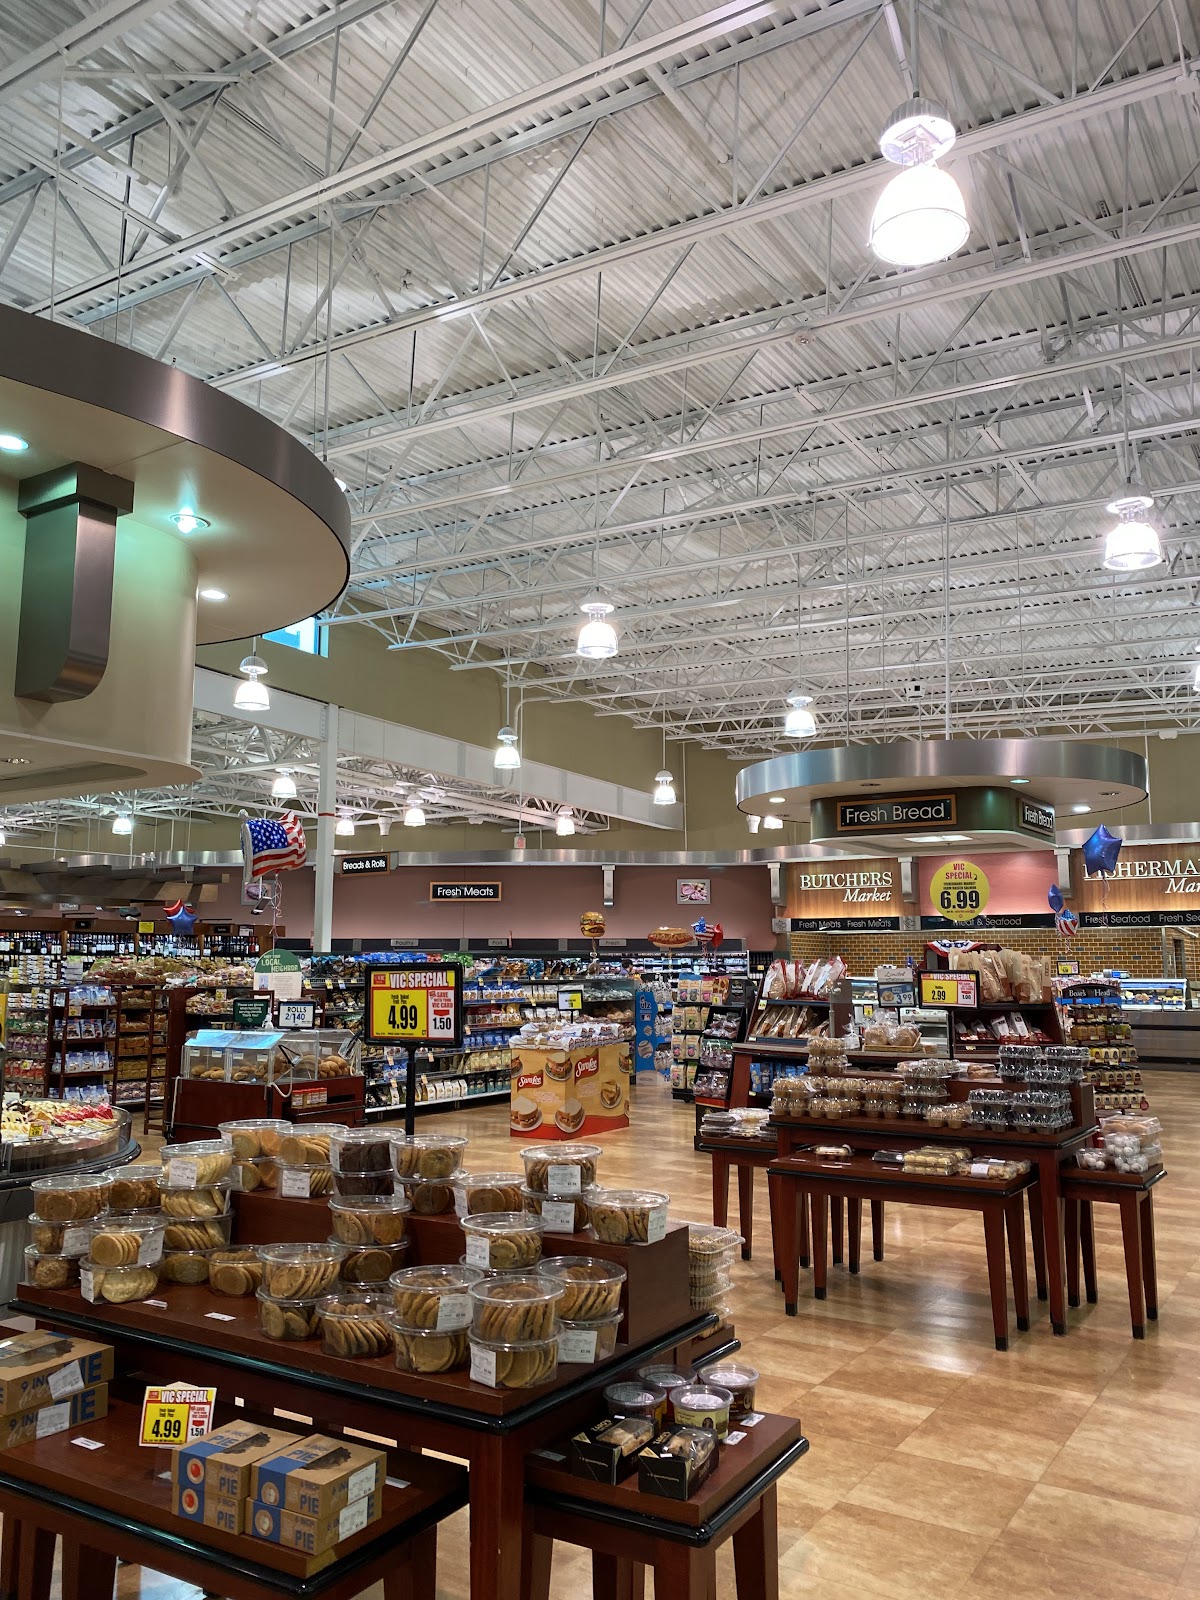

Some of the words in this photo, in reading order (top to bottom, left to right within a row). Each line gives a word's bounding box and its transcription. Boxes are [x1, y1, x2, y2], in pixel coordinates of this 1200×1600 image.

[846, 807, 888, 824] Fresh
[893, 803, 945, 821] Bread
[1025, 805, 1038, 823] Fresh
[1038, 810, 1053, 829] Bread
[343, 860, 364, 870] Breads
[365, 860, 371, 868] &
[371, 859, 386, 869] Rolls
[953, 863, 965, 871] VIC
[800, 871, 893, 889] BUTCHERS
[945, 871, 973, 880] SPECIAL
[437, 886, 462, 897] Fresh
[464, 886, 494, 897] Meats
[843, 888, 892, 903] Market
[940, 890, 980, 910] 6.99
[799, 920, 818, 930] Fresh
[819, 920, 842, 930] Meats
[847, 919, 866, 929] Fresh
[867, 919, 892, 928] Meats
[977, 917, 984, 926] &
[985, 917, 1022, 926] Seafood
[1085, 915, 1109, 924] Fresh
[1110, 914, 1151, 924] Seafood
[1159, 913, 1184, 923] Fresh
[261, 958, 281, 967] LOCAL
[271, 964, 299, 973] NEIGHBOR
[389, 973, 407, 989] VIC
[407, 971, 448, 989] SPECIAL
[945, 973, 971, 981] SPECIAL
[931, 990, 946, 1001] 2.99
[1094, 989, 1111, 997] Head
[388, 1004, 418, 1030] 4.99
[432, 1017, 452, 1030] 1.50
[21, 1380, 29, 1393] 9
[161, 1390, 175, 1403] VIC
[176, 1390, 208, 1403] SPECIAL
[9, 1418, 17, 1431] 9
[152, 1419, 182, 1439] 4.99
[190, 1427, 204, 1437] 1.50
[207, 1434, 241, 1447] PIE
[286, 1449, 321, 1462] PIE
[219, 1476, 238, 1496] PIE
[300, 1493, 320, 1516] PIE
[216, 1509, 236, 1531] PIE
[294, 1528, 315, 1551] PIE
